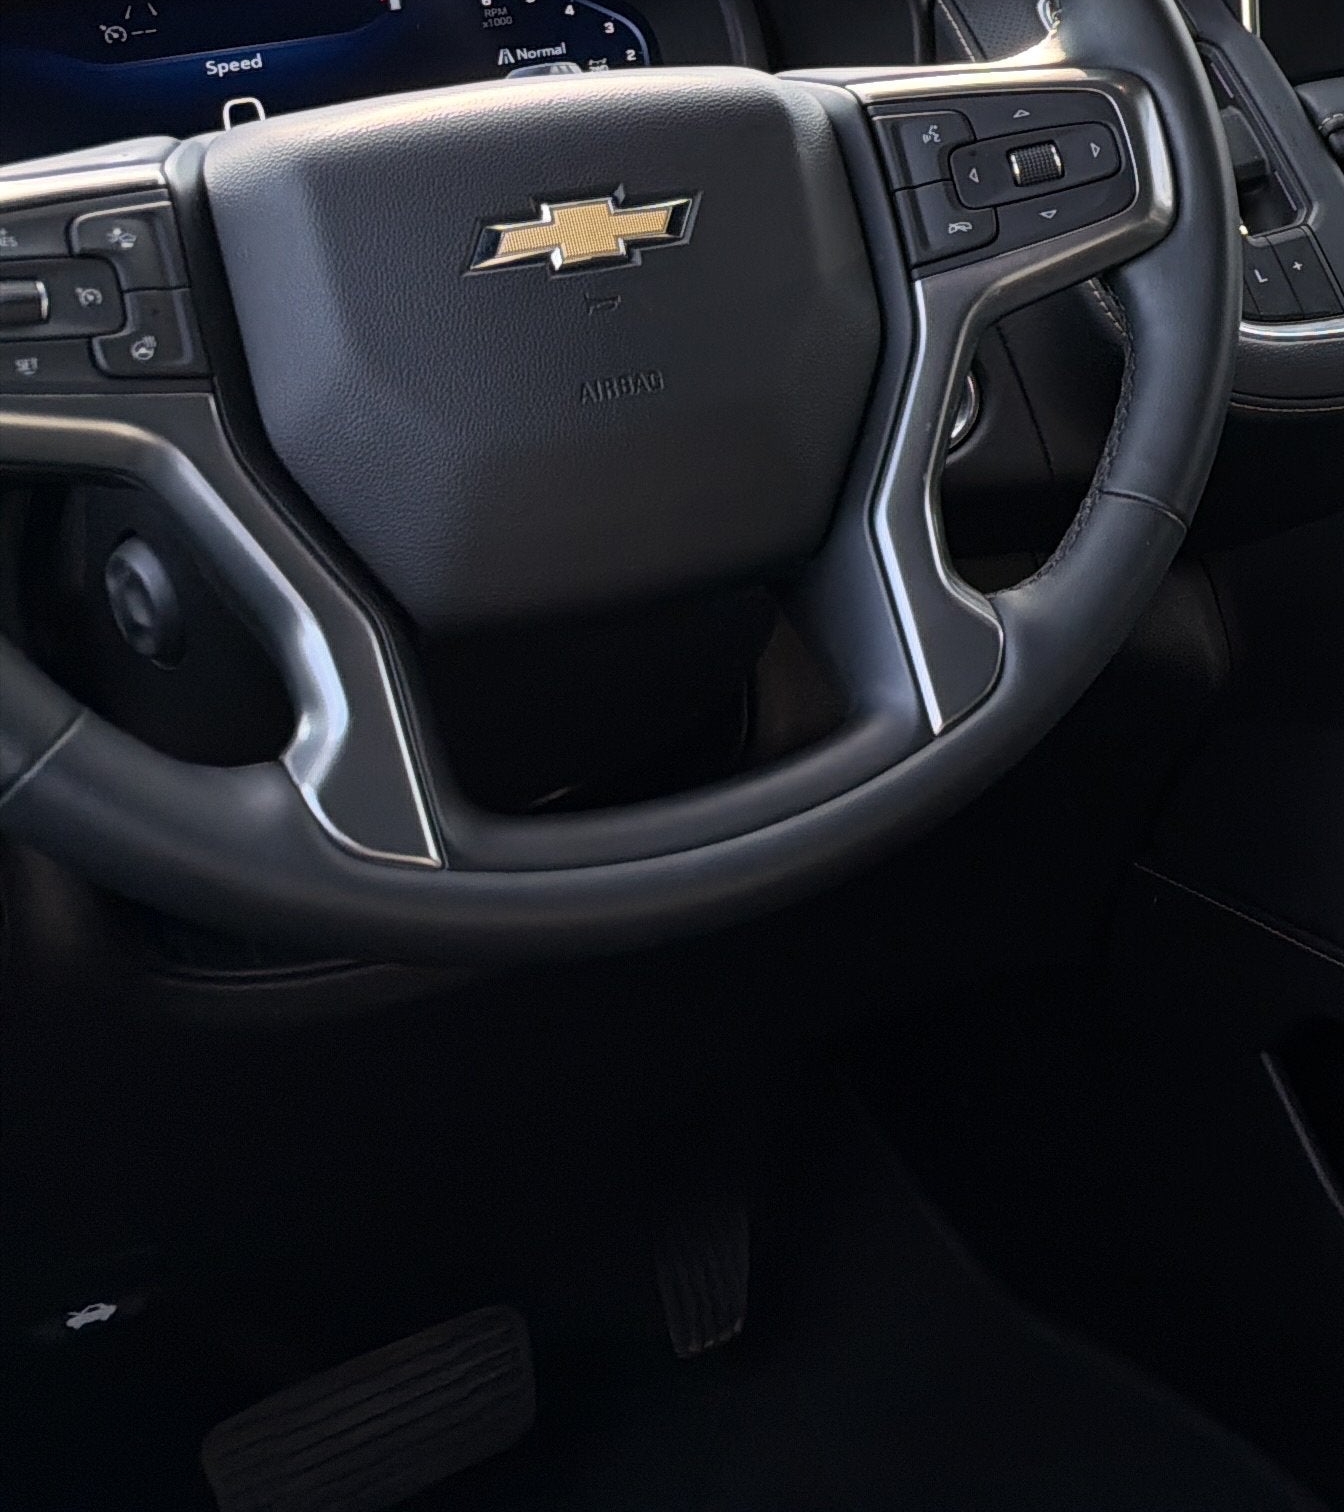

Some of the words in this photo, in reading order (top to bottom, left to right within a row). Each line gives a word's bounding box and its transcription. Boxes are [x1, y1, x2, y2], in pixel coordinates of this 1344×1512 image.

[484, 6, 508, 18] RPM
[564, 4, 575, 16] 4
[603, 22, 615, 34] 3
[516, 41, 567, 61] Normal
[626, 49, 637, 61] 2
[205, 53, 263, 78] Speed
[580, 369, 664, 405] AIRBAG
